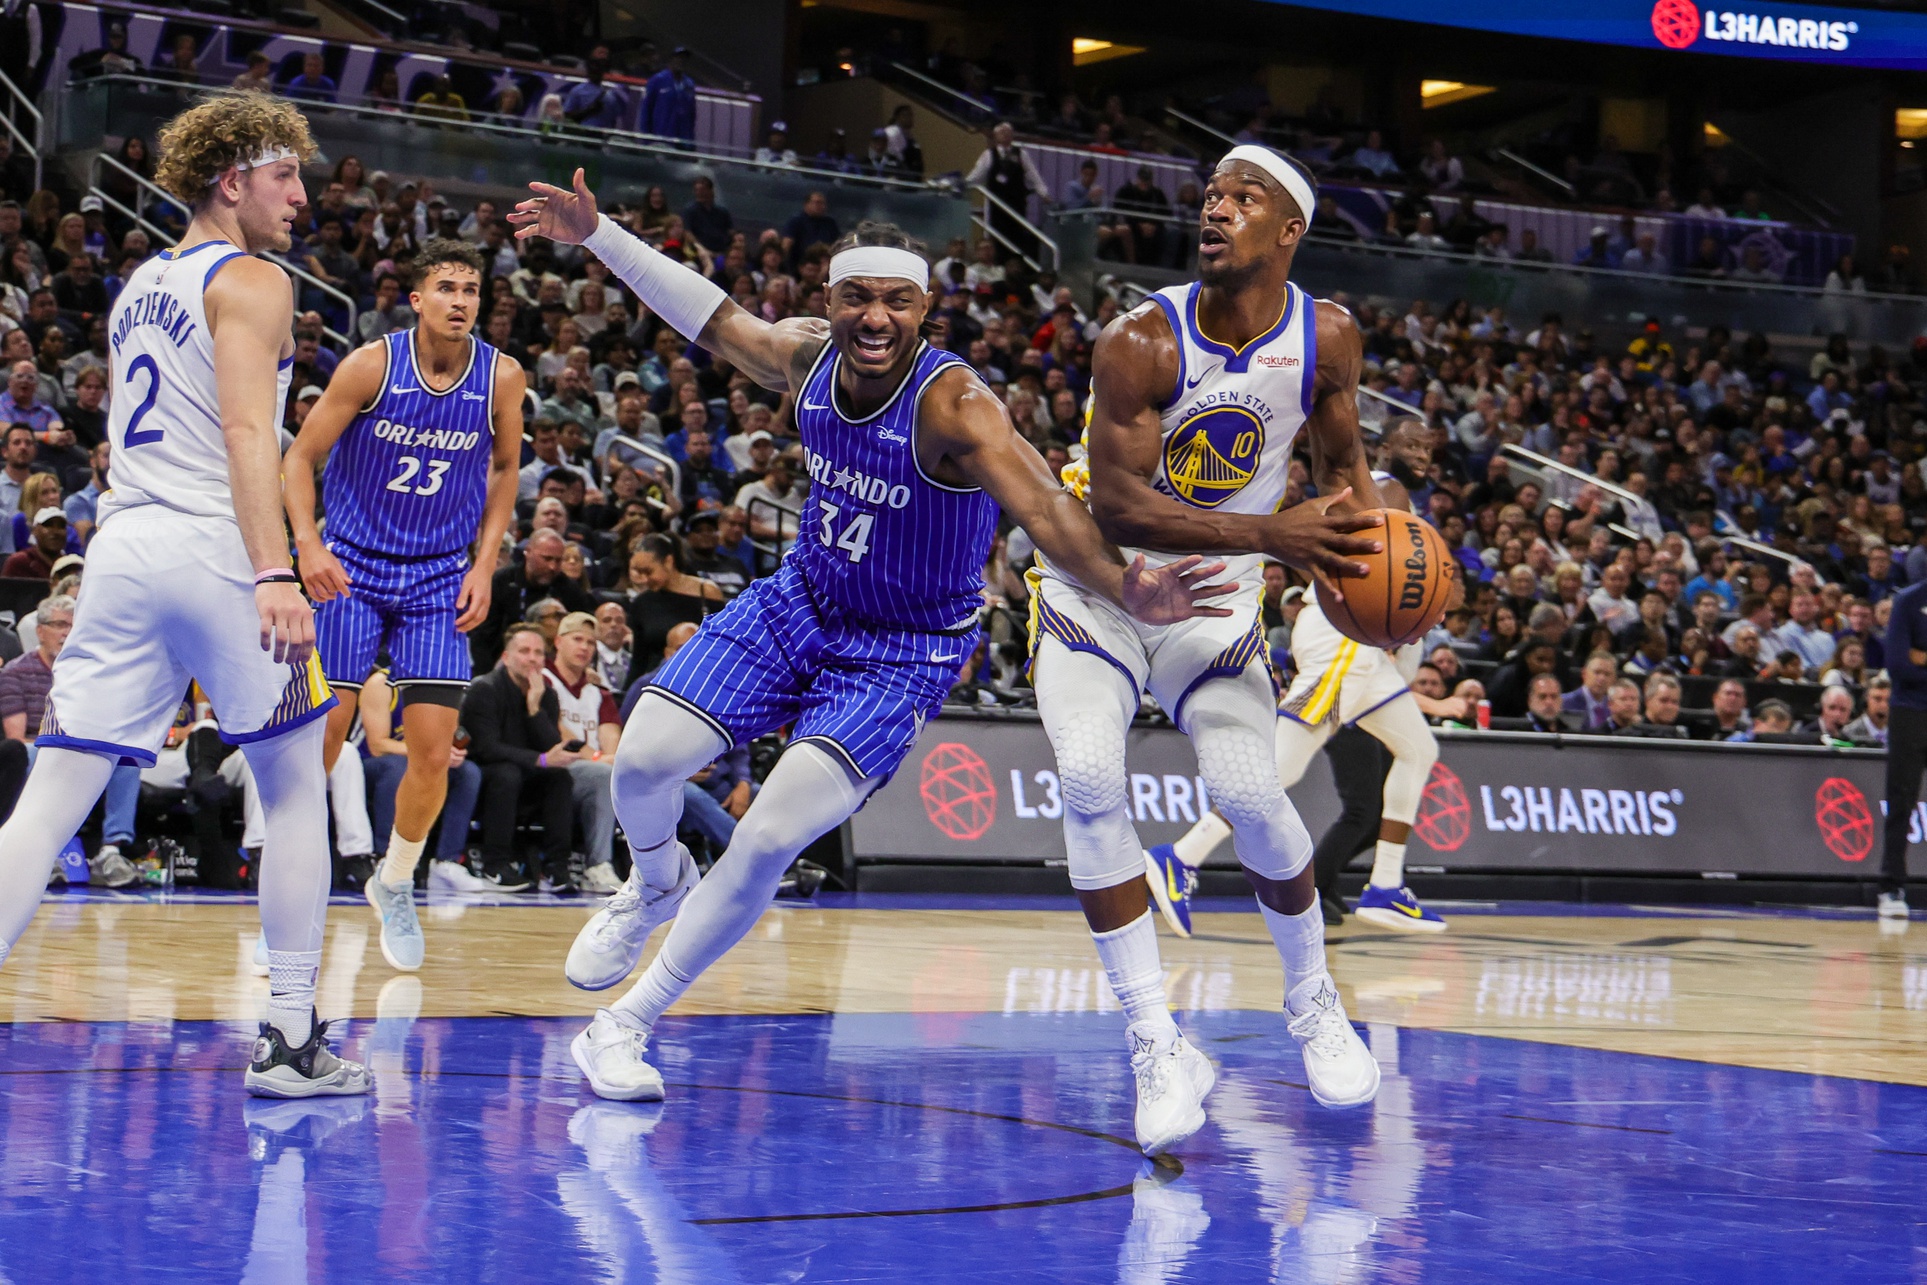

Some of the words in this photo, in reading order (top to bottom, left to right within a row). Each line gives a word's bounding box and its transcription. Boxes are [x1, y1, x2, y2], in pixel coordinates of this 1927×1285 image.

[1705, 10, 1849, 51] L3HARRIS
[112, 291, 196, 357] PODZIEMSKI
[1257, 355, 1299, 367] Rakuten
[124, 353, 164, 449] 2
[461, 390, 486, 403] Disney
[1244, 394, 1274, 424] STATE
[876, 425, 908, 446] Disney
[1230, 431, 1256, 459] 10
[386, 456, 452, 496] 23
[819, 500, 875, 563] 34
[1398, 522, 1427, 610] Wilson
[1480, 785, 1677, 837] L3HARRIS
